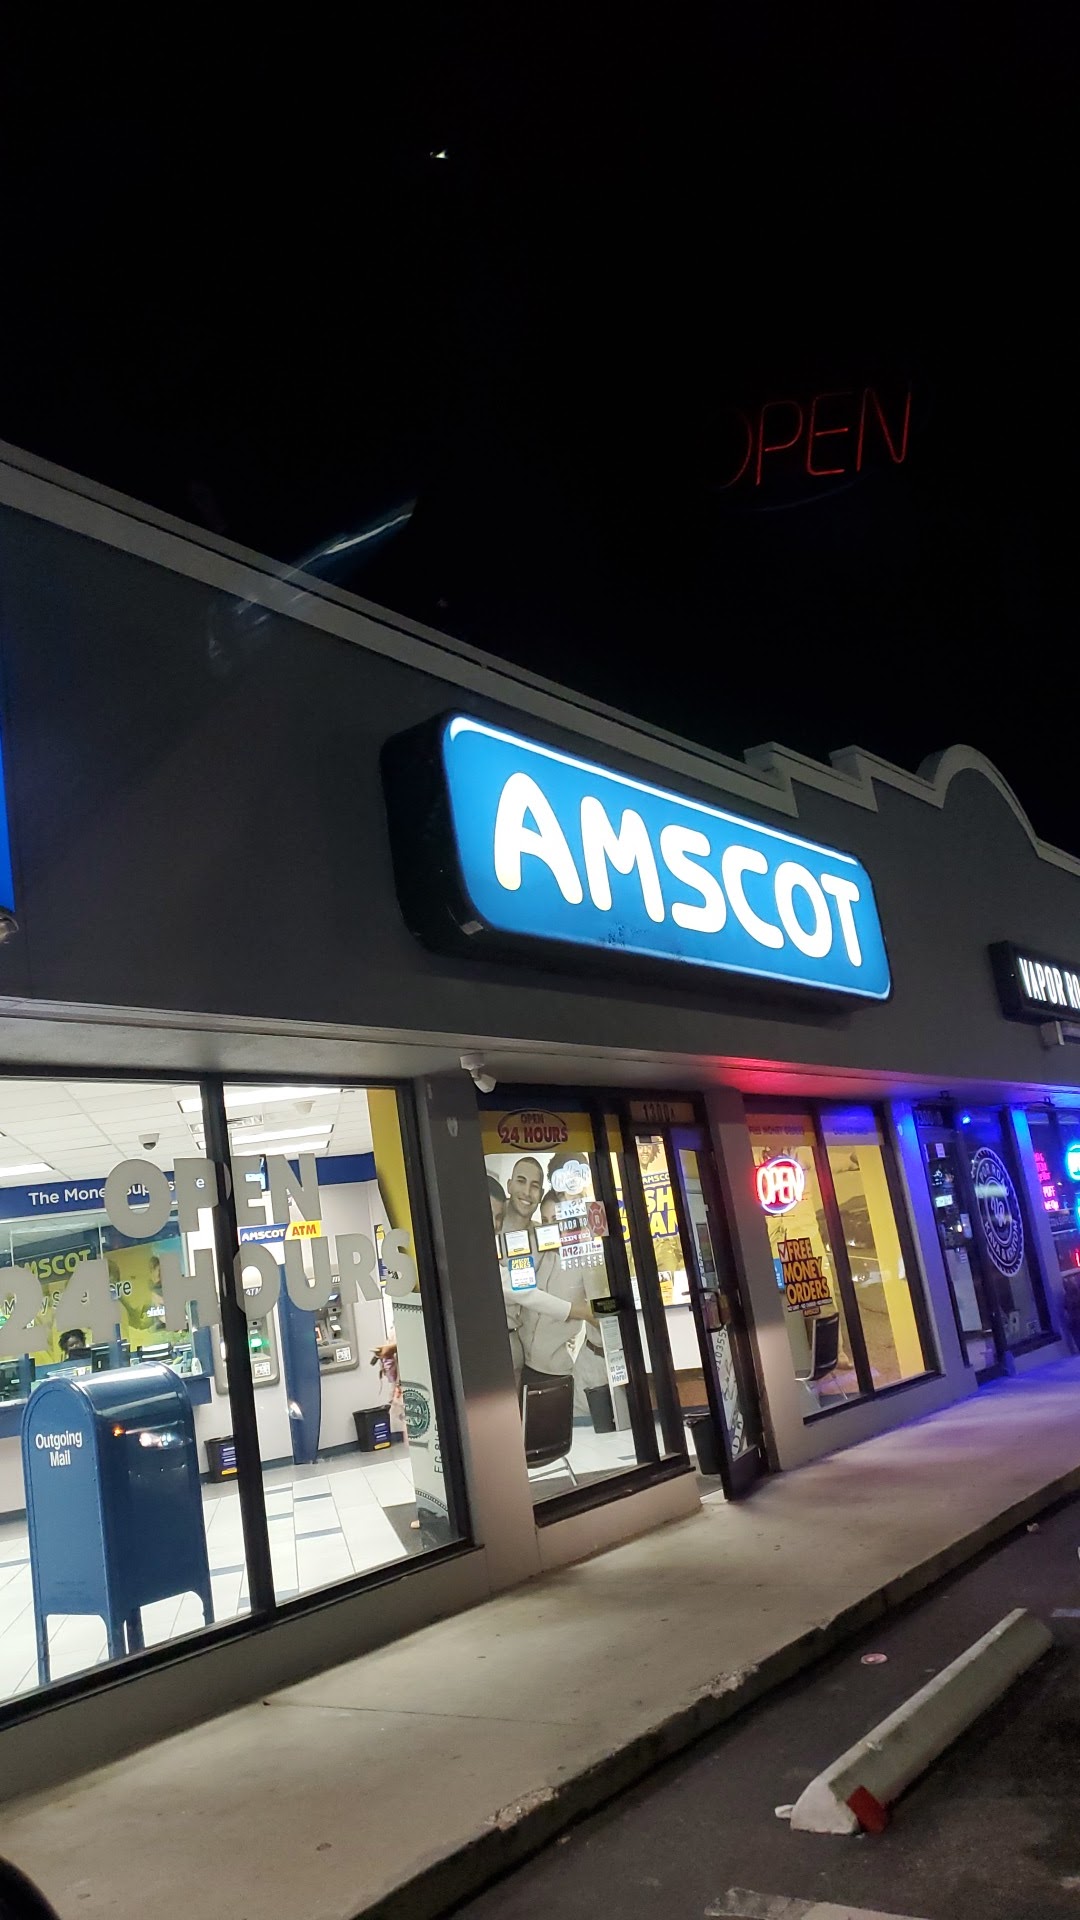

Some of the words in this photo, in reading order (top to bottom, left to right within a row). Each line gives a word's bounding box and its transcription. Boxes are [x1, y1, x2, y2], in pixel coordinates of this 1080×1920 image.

[492, 771, 864, 968] AMSCOT
[1018, 956, 1068, 1006] VAPOR
[520, 1113, 544, 1125] OPEN
[500, 1126, 520, 1143] 24
[523, 1125, 568, 1143] HOURS
[28, 1192, 60, 1206] The
[64, 1187, 105, 1202] Mone
[104, 1152, 323, 1239] OPEN
[756, 1165, 803, 1205] OPEN
[242, 1228, 286, 1242] AMSCOT
[291, 1224, 317, 1236] ATM
[786, 1238, 814, 1261] FREE
[783, 1257, 823, 1284] MONEY
[0, 1257, 122, 1356] 24
[159, 1228, 420, 1332] HOURS
[786, 1277, 831, 1306] ORDERS
[35, 1430, 83, 1450] Outgoing
[50, 1449, 72, 1467] Mail
